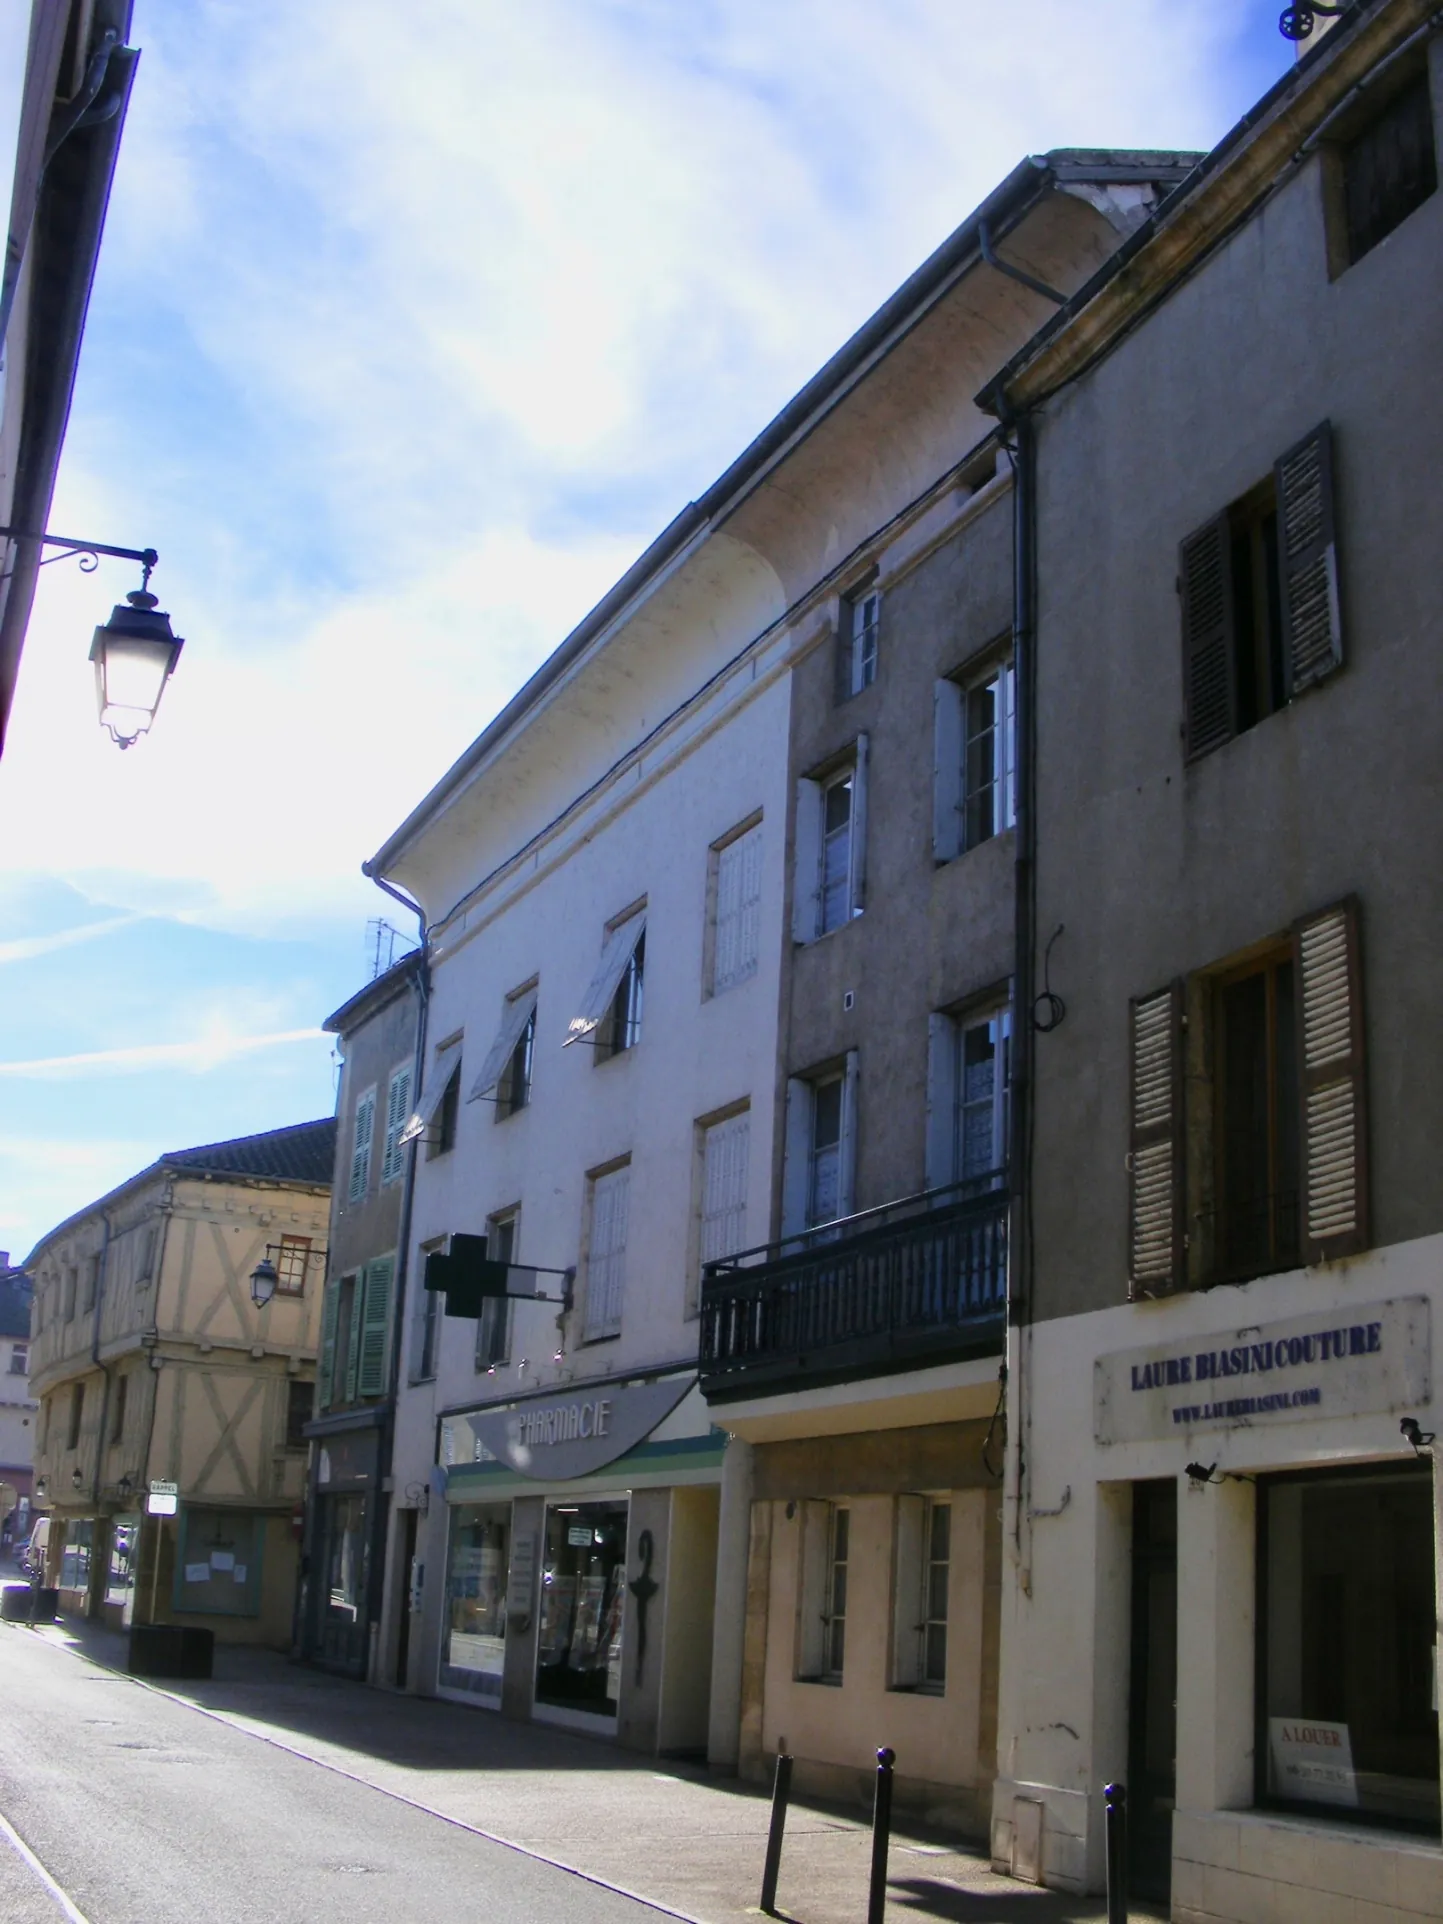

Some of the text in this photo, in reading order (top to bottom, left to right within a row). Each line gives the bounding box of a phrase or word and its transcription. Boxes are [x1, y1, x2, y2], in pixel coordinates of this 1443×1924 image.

[1131, 1322, 1382, 1391] LAURE BIASINI COUTURE
[518, 1399, 611, 1446] PHARMACIE
[1281, 1726, 1342, 1747] A LOUER
